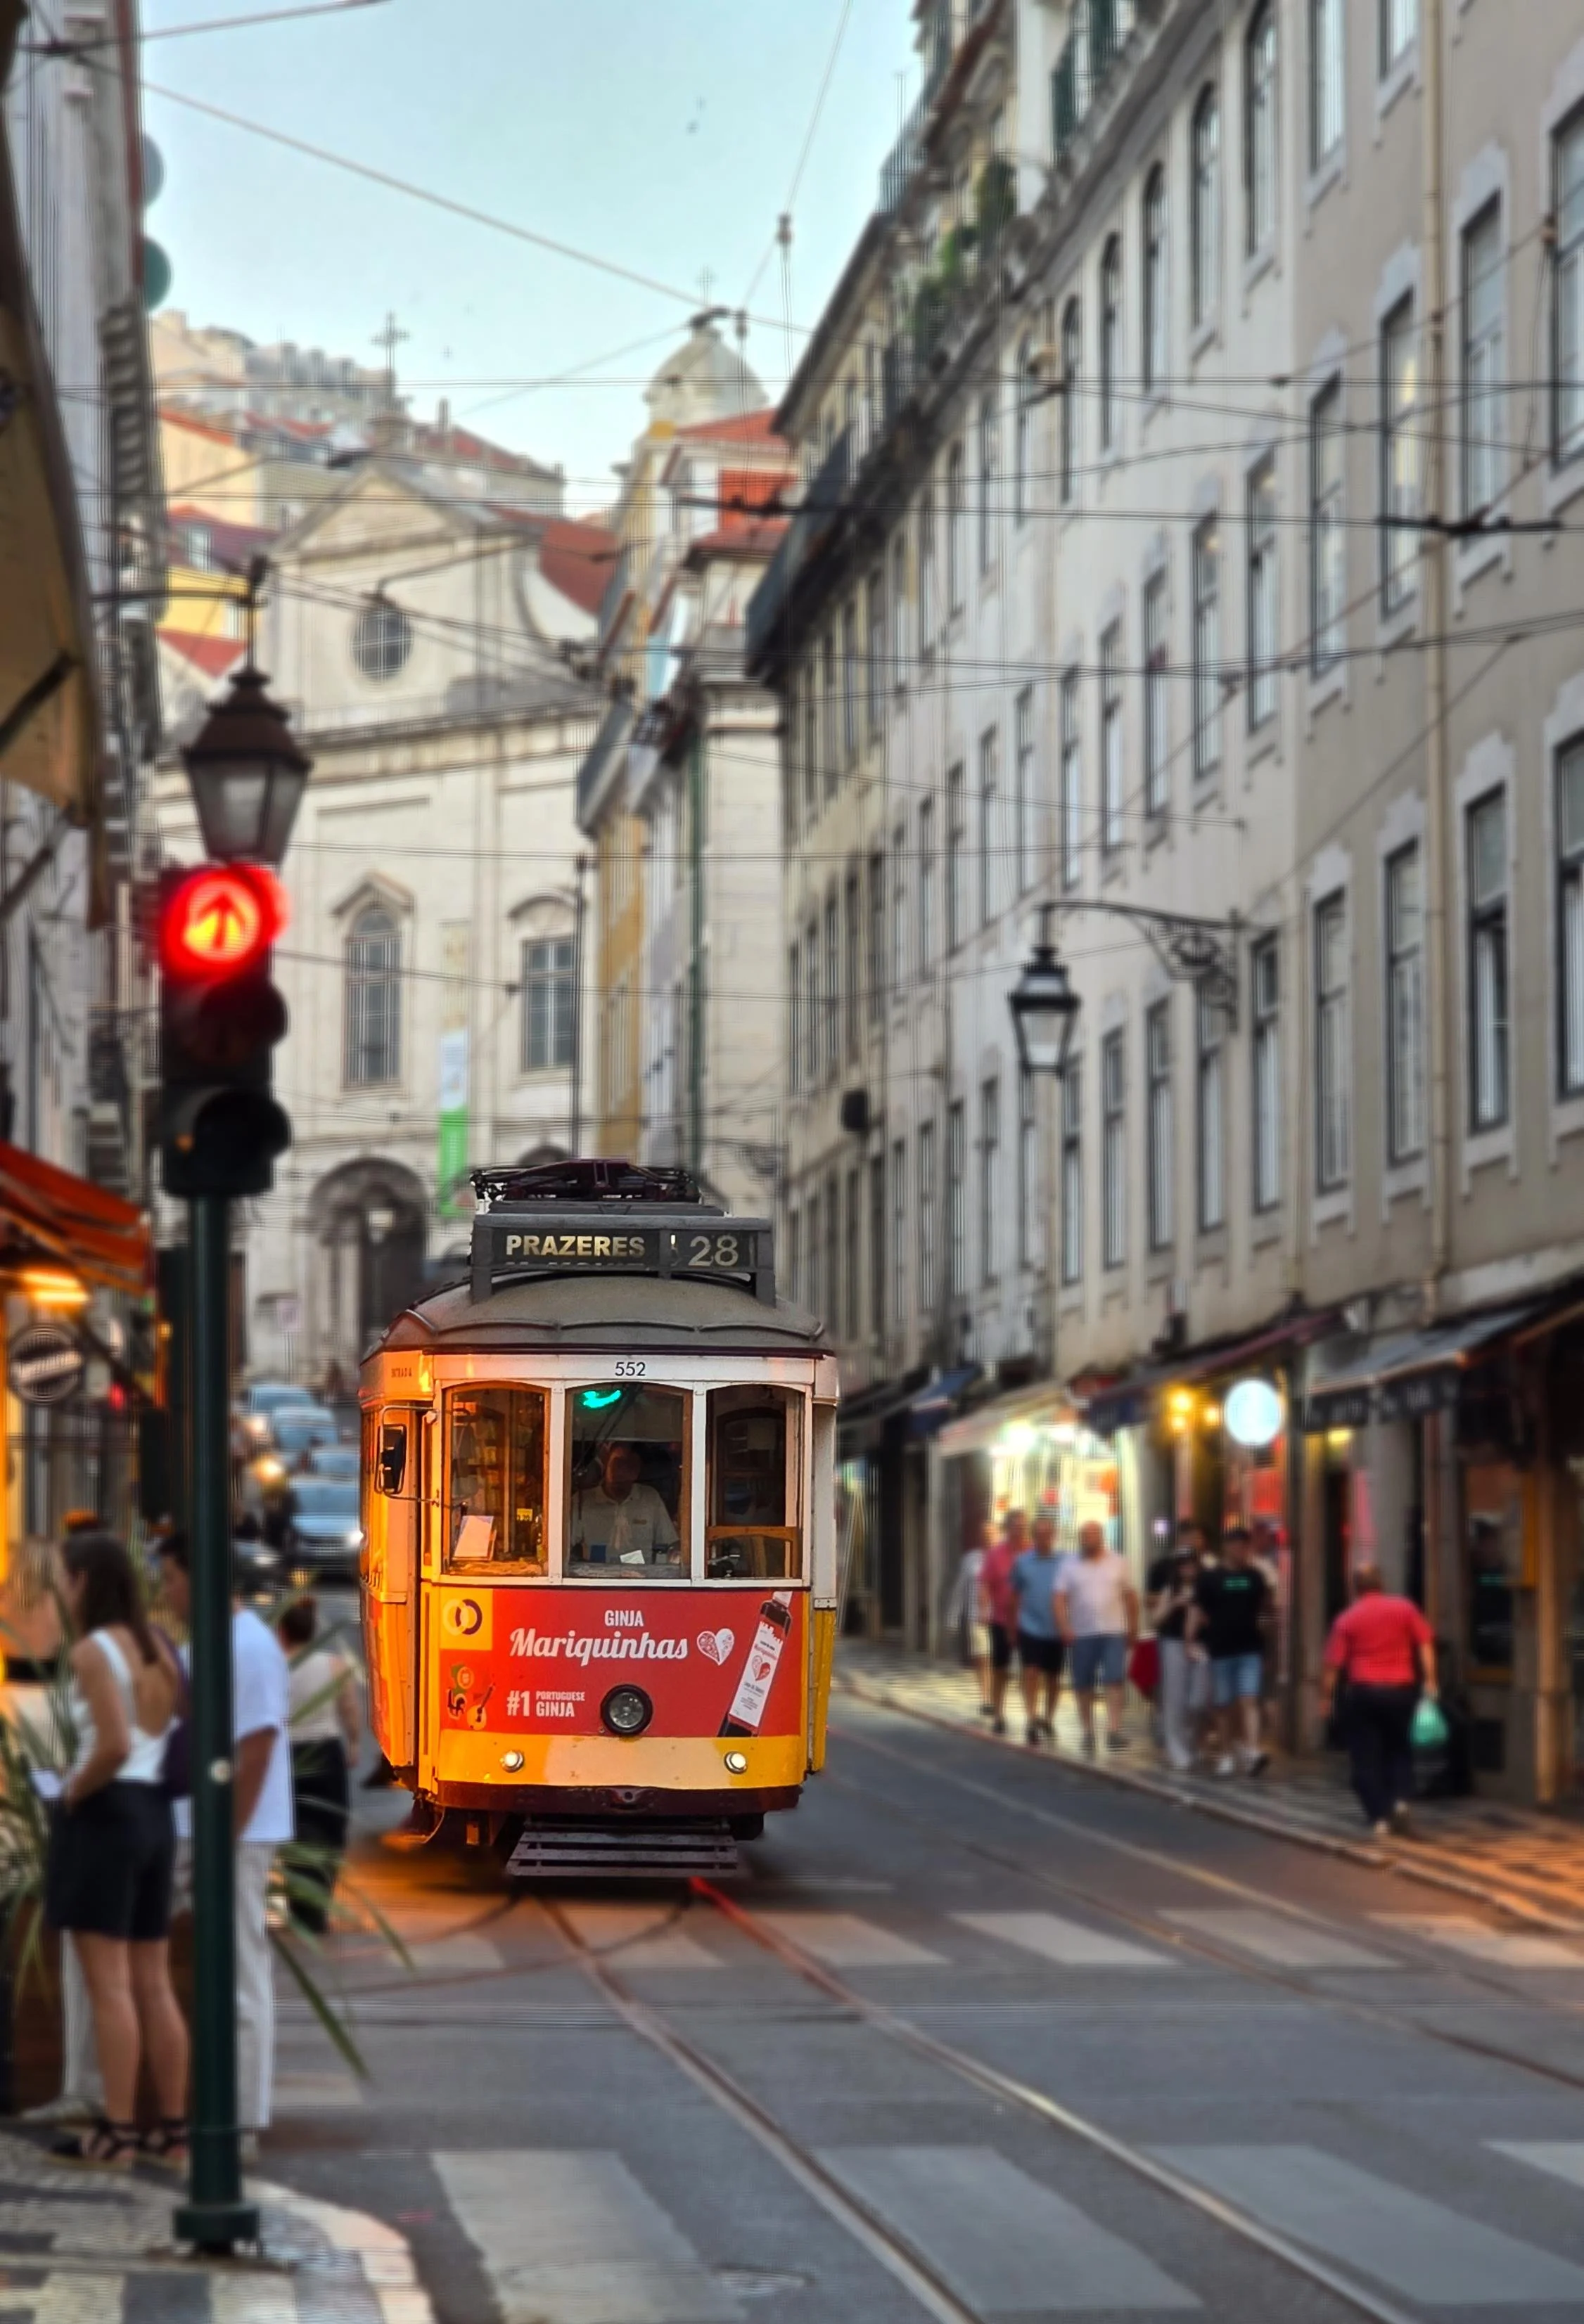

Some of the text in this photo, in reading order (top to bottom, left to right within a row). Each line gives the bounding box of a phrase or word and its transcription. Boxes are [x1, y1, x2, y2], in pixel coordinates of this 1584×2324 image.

[506, 1234, 739, 1266] PRAZERES 28
[615, 1361, 646, 1376] 552
[604, 1610, 644, 1626] GINJA
[509, 1628, 689, 1667] Mariquinhas
[506, 1690, 530, 1716] #1
[536, 1690, 585, 1701] PORTUGUESE
[536, 1701, 575, 1716] GINJA
